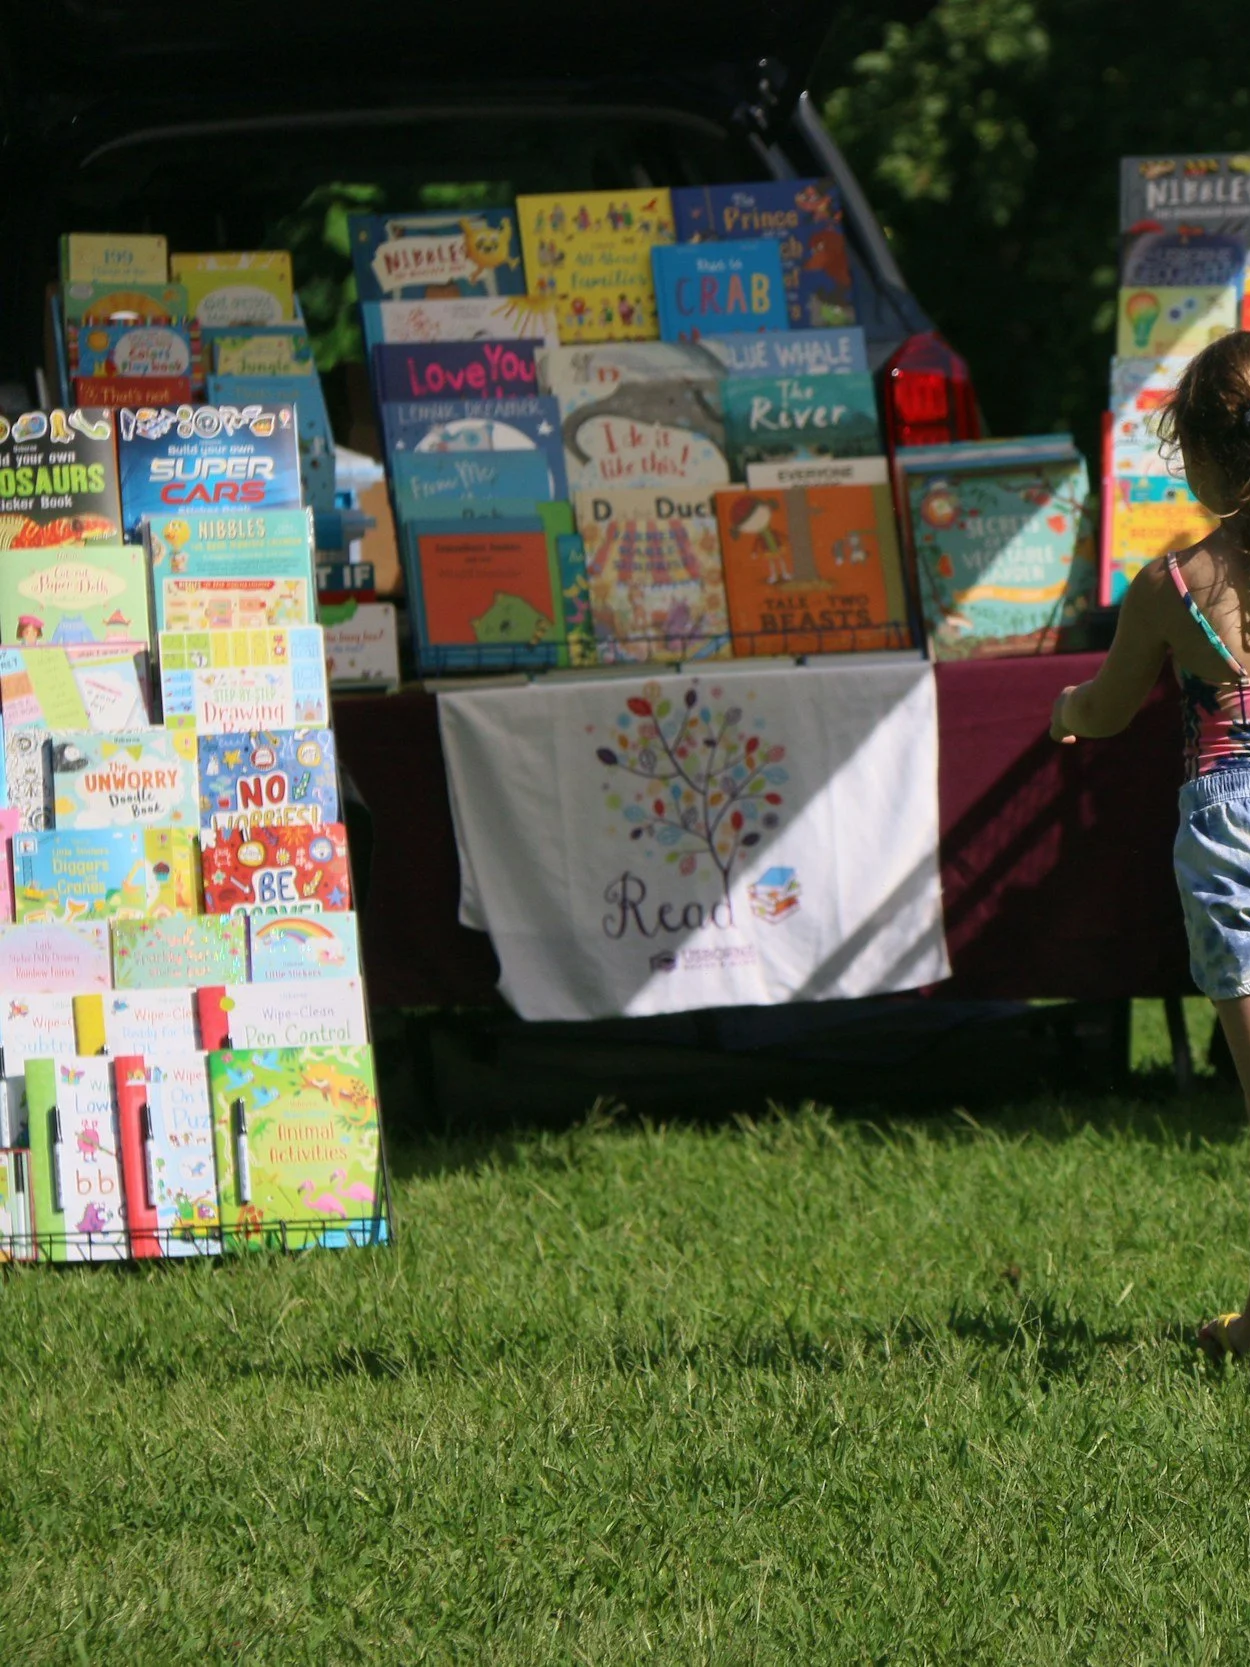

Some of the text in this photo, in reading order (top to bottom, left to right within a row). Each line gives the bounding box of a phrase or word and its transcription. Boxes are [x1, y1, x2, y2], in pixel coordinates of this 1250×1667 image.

[724, 206, 799, 232] Prince
[675, 272, 771, 316] CRAB
[727, 336, 854, 369] LUE WHALE
[407, 343, 537, 397] Love You
[750, 396, 848, 434] River
[16, 452, 44, 466] your
[48, 450, 76, 463] own
[168, 443, 254, 457] Build your own
[0, 461, 105, 496] OSAURS
[149, 456, 275, 482] SUPER
[777, 465, 854, 482] EVERYONE
[0, 495, 73, 511] icker Book
[160, 481, 267, 505] CARS
[198, 517, 267, 542] NIBBLES
[213, 685, 277, 702] STEP-BY-STEP
[204, 699, 285, 724] Drawing
[84, 769, 178, 793] UNWORRY
[239, 774, 286, 809] NO
[108, 787, 156, 807] Doodle
[131, 802, 165, 820] Book
[52, 856, 110, 877] Diggers
[57, 877, 106, 896] Cranes
[258, 871, 294, 903] BE
[602, 870, 736, 940] Read
[261, 1005, 336, 1022] Wipe-Clean
[245, 1021, 352, 1047] Pen Control
[277, 1120, 336, 1141] Animal
[268, 1143, 349, 1165] Activities
